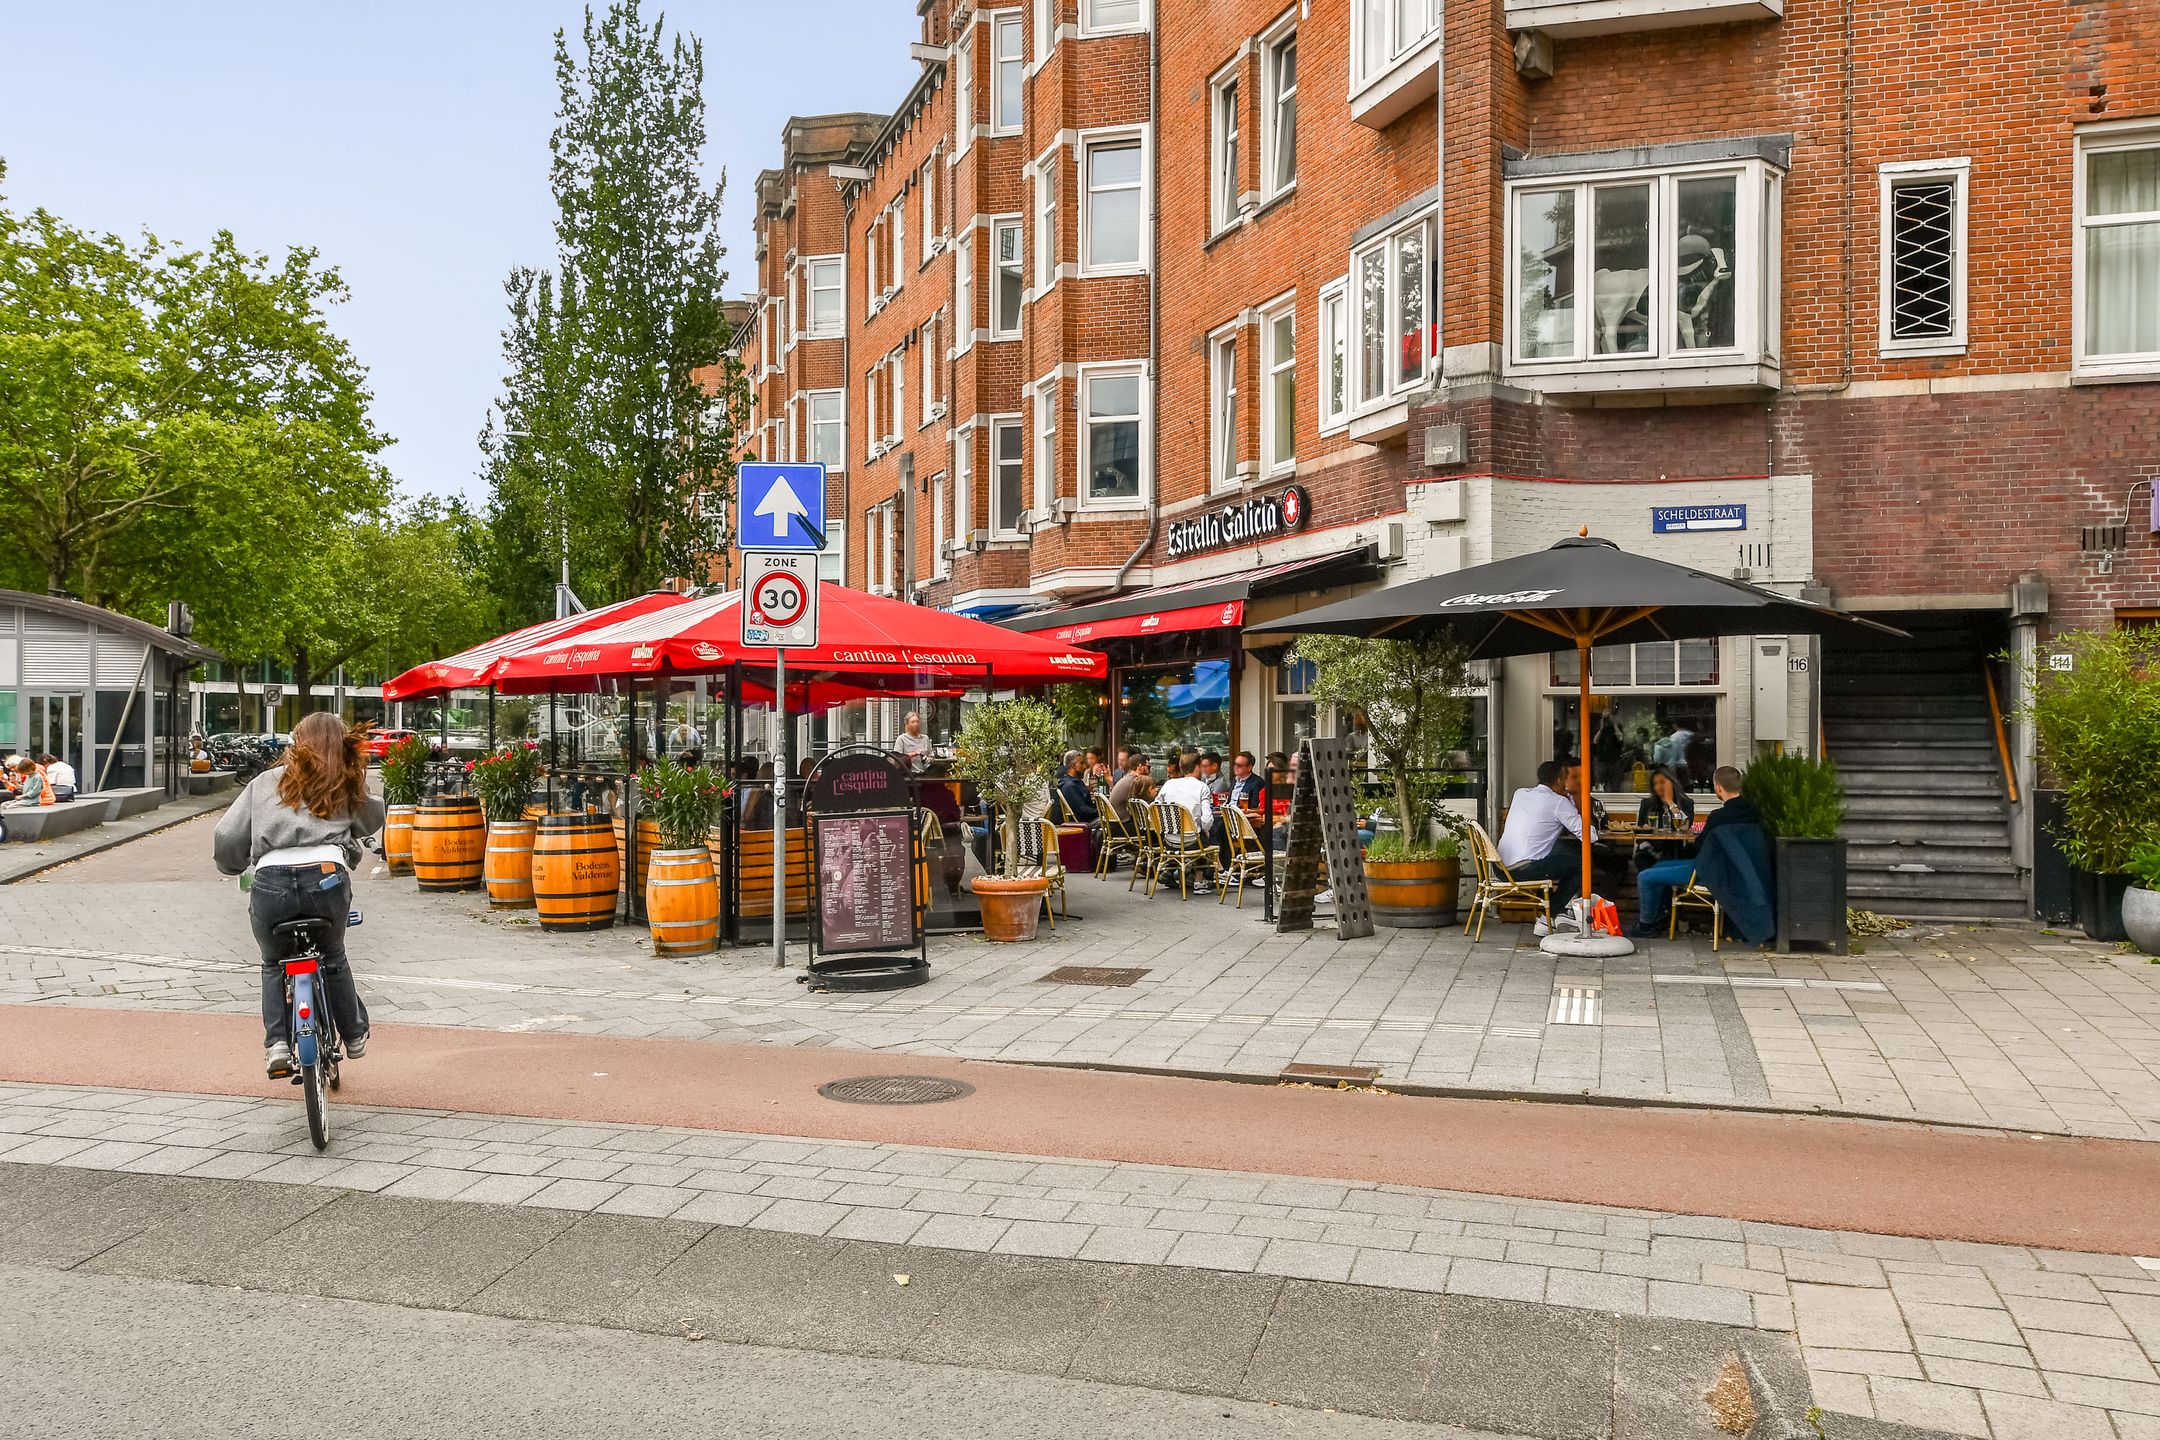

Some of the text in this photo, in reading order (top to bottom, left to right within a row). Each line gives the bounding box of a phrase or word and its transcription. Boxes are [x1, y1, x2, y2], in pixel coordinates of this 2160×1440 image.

[1658, 507, 1740, 521] SCHELDESTRAAT
[1168, 496, 1278, 556] Estrella Galicia
[764, 557, 797, 567] ZONE
[763, 588, 797, 610] 30
[543, 651, 567, 665] cantina
[833, 650, 896, 663] cantina
[1048, 653, 1096, 666] LAVAZZA
[2052, 656, 2071, 669] 114
[1788, 658, 1807, 671] 116
[841, 770, 887, 781] cantina
[576, 861, 611, 871] Bodegas
